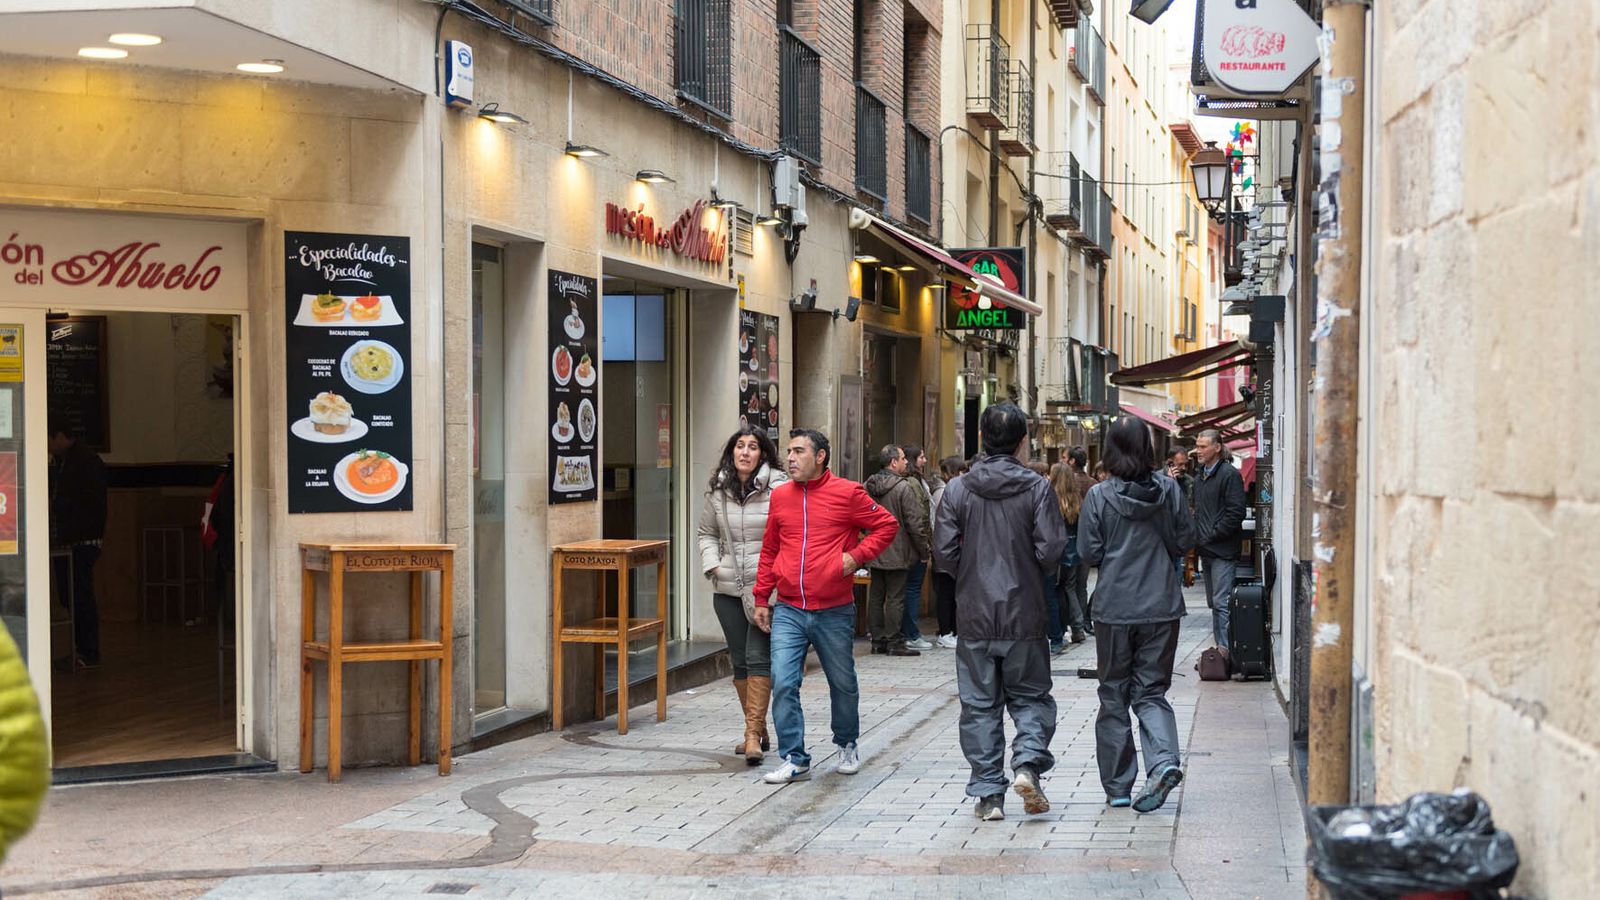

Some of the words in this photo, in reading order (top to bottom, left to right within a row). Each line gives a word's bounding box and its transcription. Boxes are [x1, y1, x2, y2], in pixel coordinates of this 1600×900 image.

[1220, 62, 1286, 71] RESTAURANTE
[299, 242, 396, 271] Especialidades
[15, 268, 44, 285] del
[51, 242, 223, 291] Abuelo
[322, 263, 374, 281] Bacalao
[973, 260, 999, 277] BAR
[956, 310, 1013, 327] ANGEL
[346, 556, 360, 567] EL
[362, 556, 391, 567] COTO
[393, 556, 407, 566] DE
[410, 555, 440, 568] RIOJA
[564, 555, 586, 564] COTO
[587, 556, 616, 565] MAYOR
